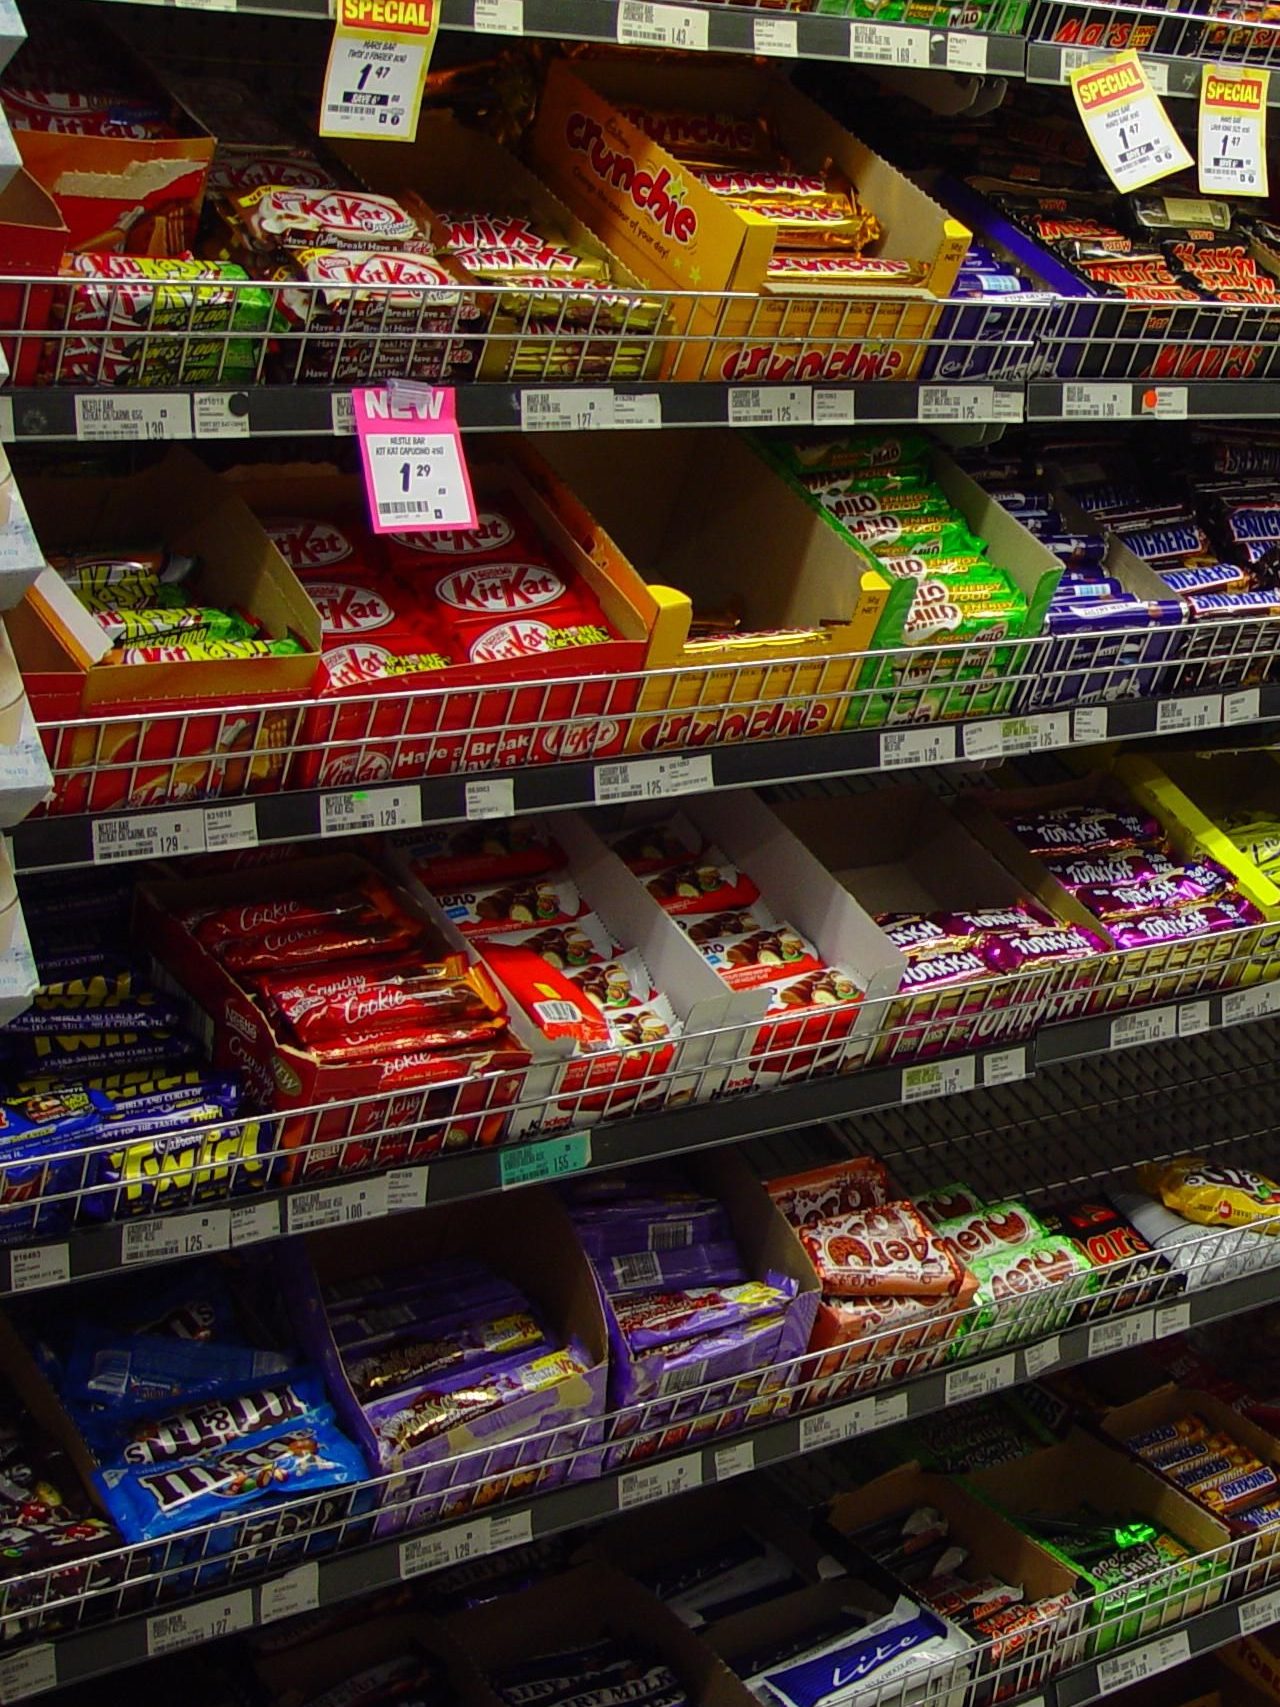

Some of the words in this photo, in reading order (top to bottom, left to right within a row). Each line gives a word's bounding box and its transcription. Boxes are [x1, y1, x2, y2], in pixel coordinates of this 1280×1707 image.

[344, 0, 430, 28] SPECIAL
[357, 63, 373, 90] 1
[375, 66, 390, 80] 47
[1079, 68, 1142, 104] SPECIAL
[1207, 81, 1260, 103] SPECIAL
[1118, 128, 1129, 149] 1
[1129, 123, 1139, 134] 47
[1221, 135, 1229, 156] 1
[1231, 137, 1241, 147] 47
[565, 111, 698, 244] Crunchie
[300, 197, 385, 226] KitKat
[337, 241, 367, 250] Break!
[367, 243, 388, 251] Have
[636, 223, 655, 246] your
[345, 261, 428, 285] KitKat
[722, 344, 903, 379] Crunchie
[399, 462, 411, 493] 1
[416, 464, 431, 477] 29
[825, 500, 877, 517] MILO
[903, 516, 950, 525] ENERGY
[928, 556, 979, 566] ENERGY
[451, 566, 554, 609] KitKat
[950, 582, 1001, 592] ENERGY
[952, 591, 992, 601] FOOD
[1193, 589, 1280, 610] SNICKERS
[963, 601, 1013, 611] ENERGY
[473, 621, 549, 663] KitKat
[642, 703, 828, 753] Crunchie
[397, 746, 451, 767] Have
[471, 735, 530, 758] Break
[1038, 823, 1107, 843] TURKISH
[1067, 860, 1134, 885] TURKISH
[239, 901, 300, 931] Cookie
[1138, 914, 1208, 939] TURKISH
[264, 928, 322, 951] Cookie
[1012, 932, 1089, 955] TURKISH
[308, 975, 367, 998] Crunchy
[344, 988, 406, 1024] Cookie
[272, 1056, 298, 1092] NEW
[110, 1122, 262, 1200] Twirl
[1222, 1466, 1275, 1499] SNICKERS
[831, 1634, 919, 1688] Lite
